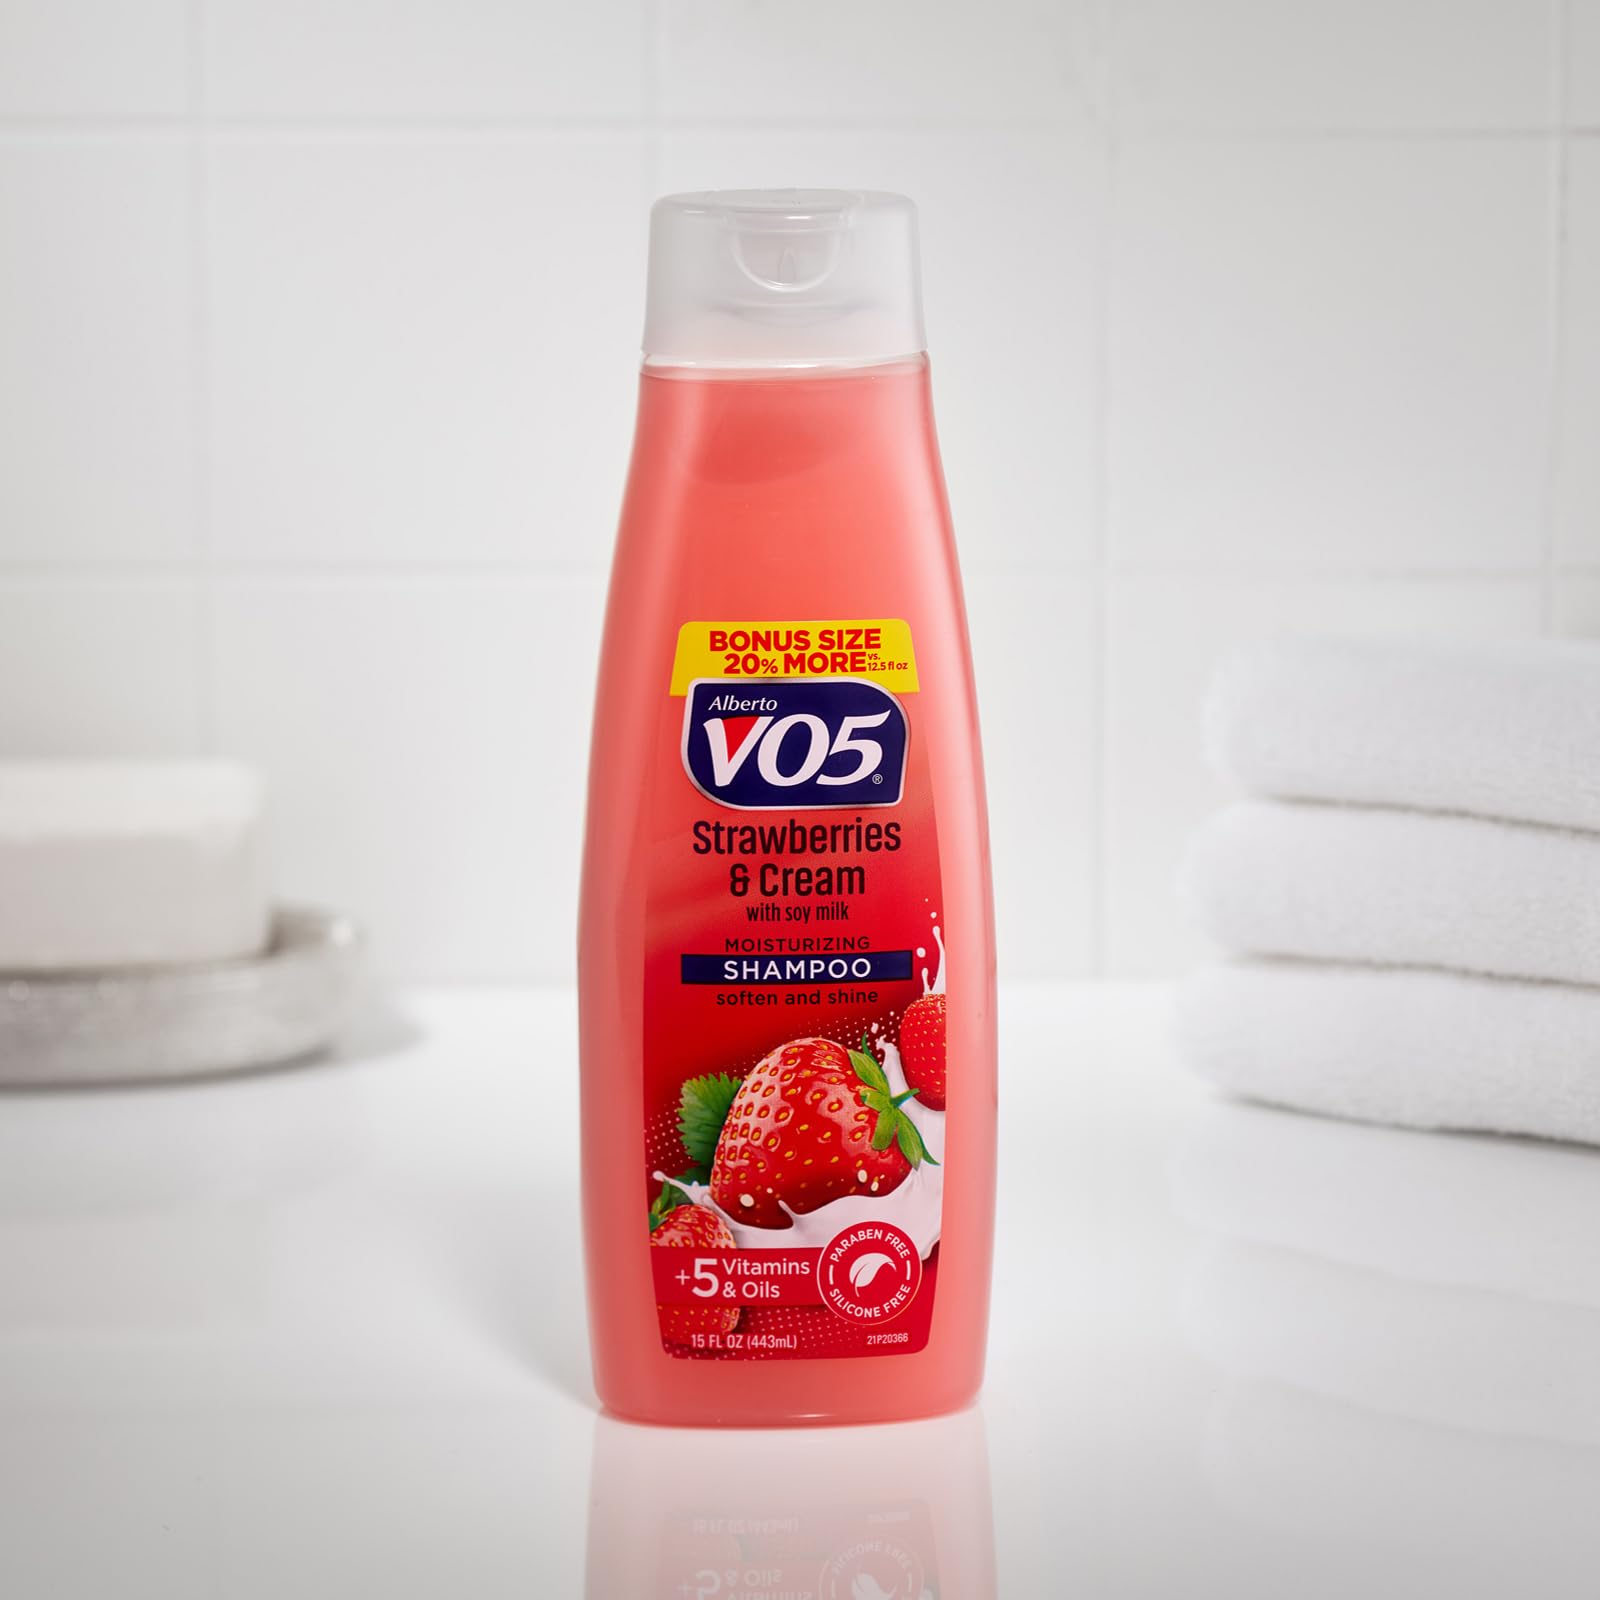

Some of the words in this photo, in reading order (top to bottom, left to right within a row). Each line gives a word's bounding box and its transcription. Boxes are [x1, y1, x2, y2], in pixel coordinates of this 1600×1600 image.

[709, 630, 811, 652] BONUS
[818, 628, 881, 650] SIZE
[723, 653, 778, 674] 20%
[783, 651, 867, 674] MORE
[867, 662, 886, 671] 12.5
[888, 661, 895, 670] fl
[896, 662, 908, 670] oz
[708, 696, 778, 711] Alberto
[703, 709, 891, 787] VO5
[692, 817, 902, 855] Strawberries
[730, 863, 750, 897] &
[760, 863, 866, 897] Cream
[746, 902, 781, 922] with
[785, 904, 811, 924] soy
[816, 901, 849, 921] milk
[725, 936, 871, 952] MOISTURIZING
[723, 958, 872, 980] SHAMPOO
[716, 990, 778, 1006] soften
[785, 989, 821, 1005] and
[828, 988, 879, 1004] shine
[829, 1228, 883, 1263] PARABEN
[884, 1232, 911, 1259] FREE
[675, 1258, 719, 1298] +5
[722, 1258, 810, 1276] Vitamins
[722, 1281, 737, 1298] &
[741, 1281, 781, 1299] Oils
[829, 1288, 882, 1318] SILICONE
[882, 1283, 911, 1313] FREE
[691, 1335, 705, 1348] 15
[709, 1335, 723, 1348] FL
[727, 1335, 743, 1348] OZ
[747, 1334, 798, 1350] (443mL)
[867, 1333, 909, 1345] 21P20366
